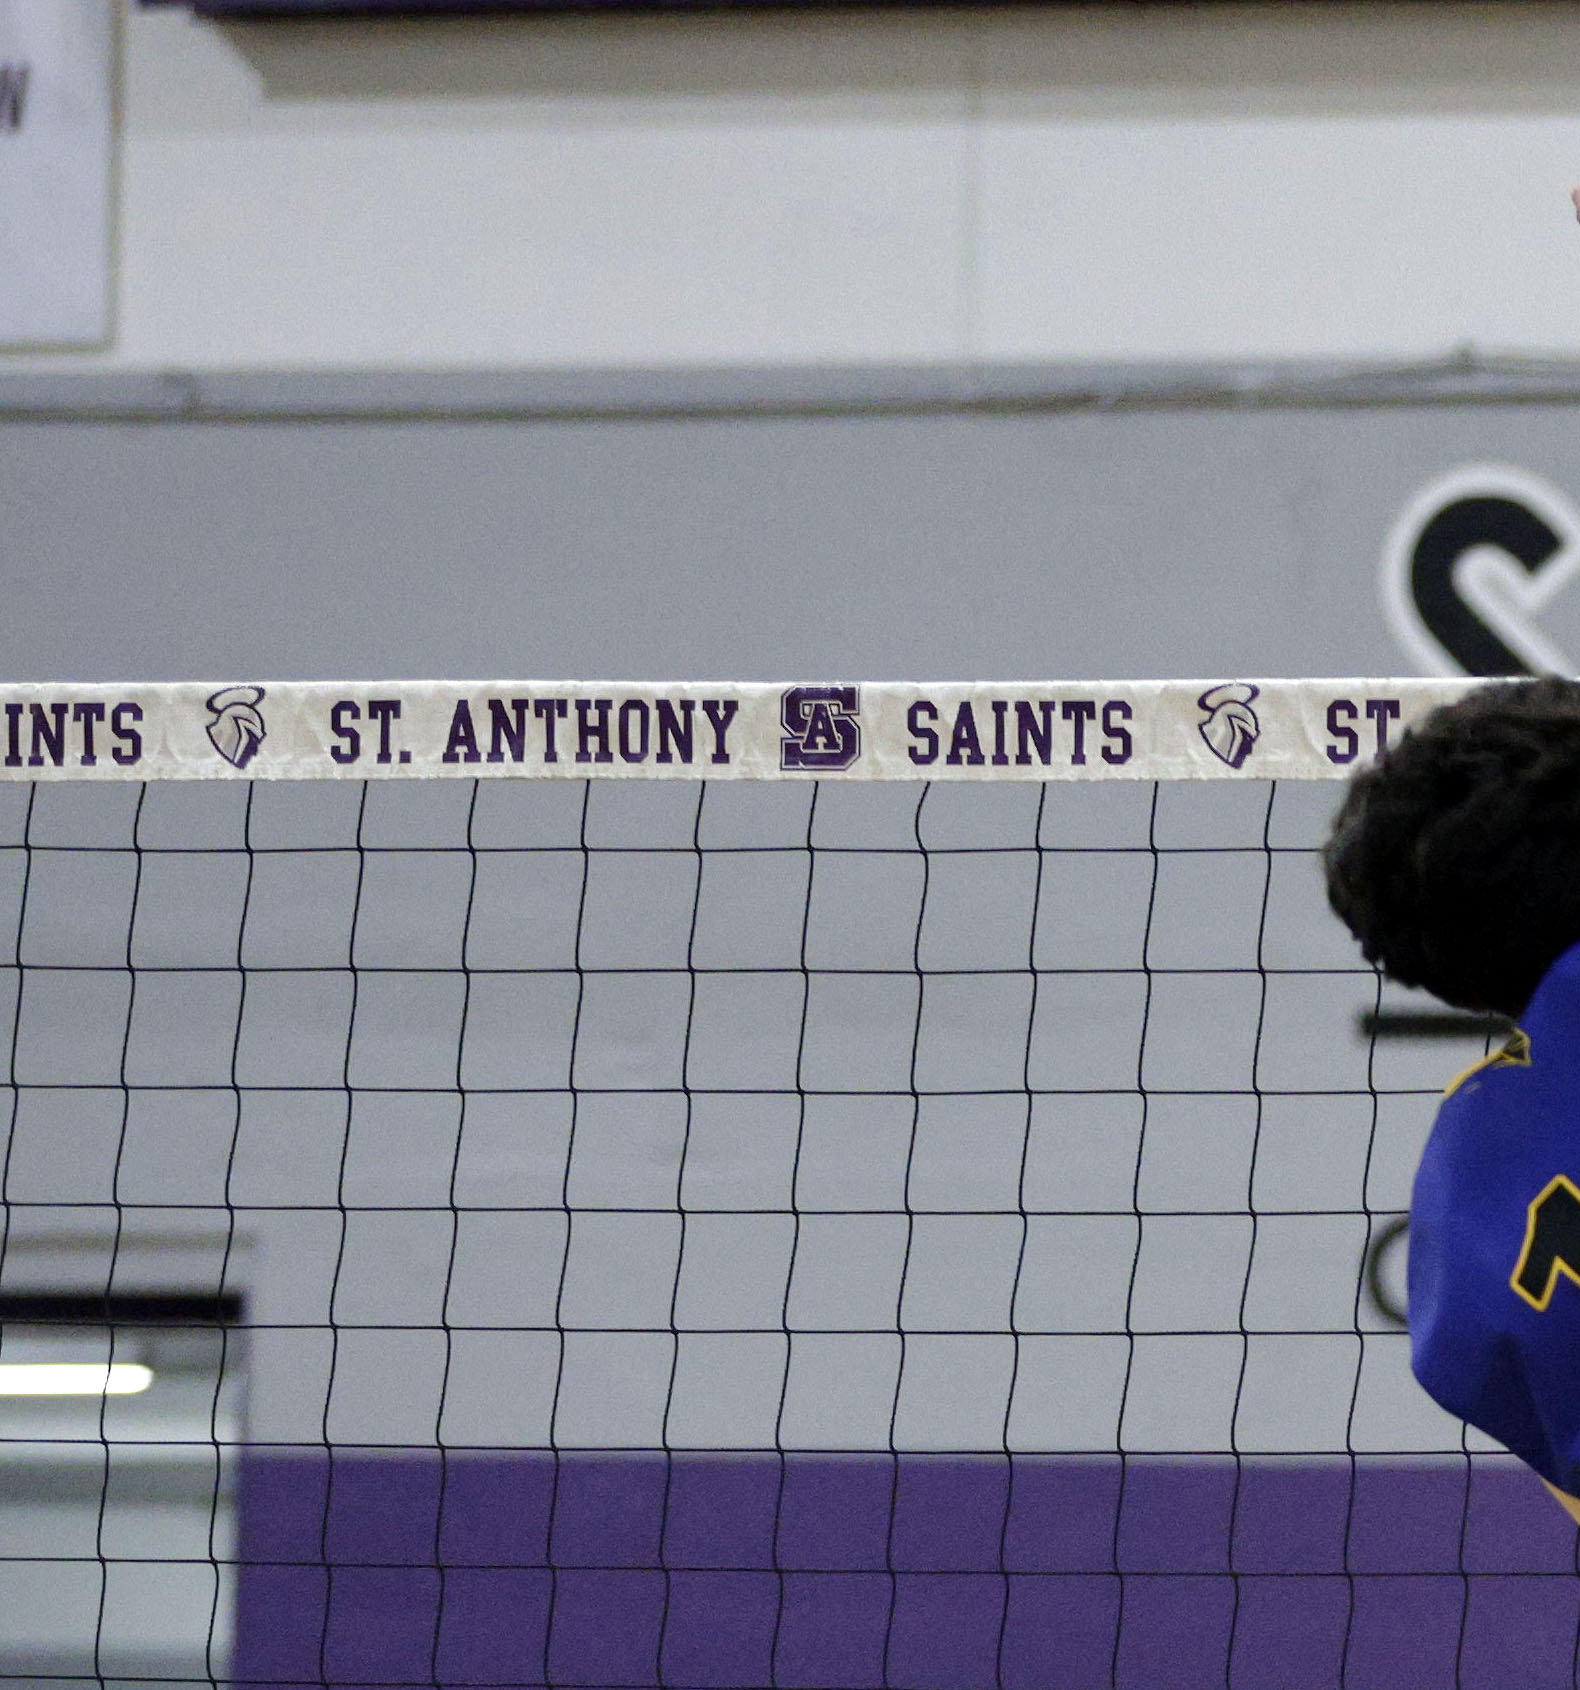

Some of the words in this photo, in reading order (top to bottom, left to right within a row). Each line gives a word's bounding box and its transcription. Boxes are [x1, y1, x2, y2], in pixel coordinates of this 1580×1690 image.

[330, 700, 411, 764] ST.
[442, 698, 738, 764] ANTHONY
[907, 700, 1132, 766] SAINTS
